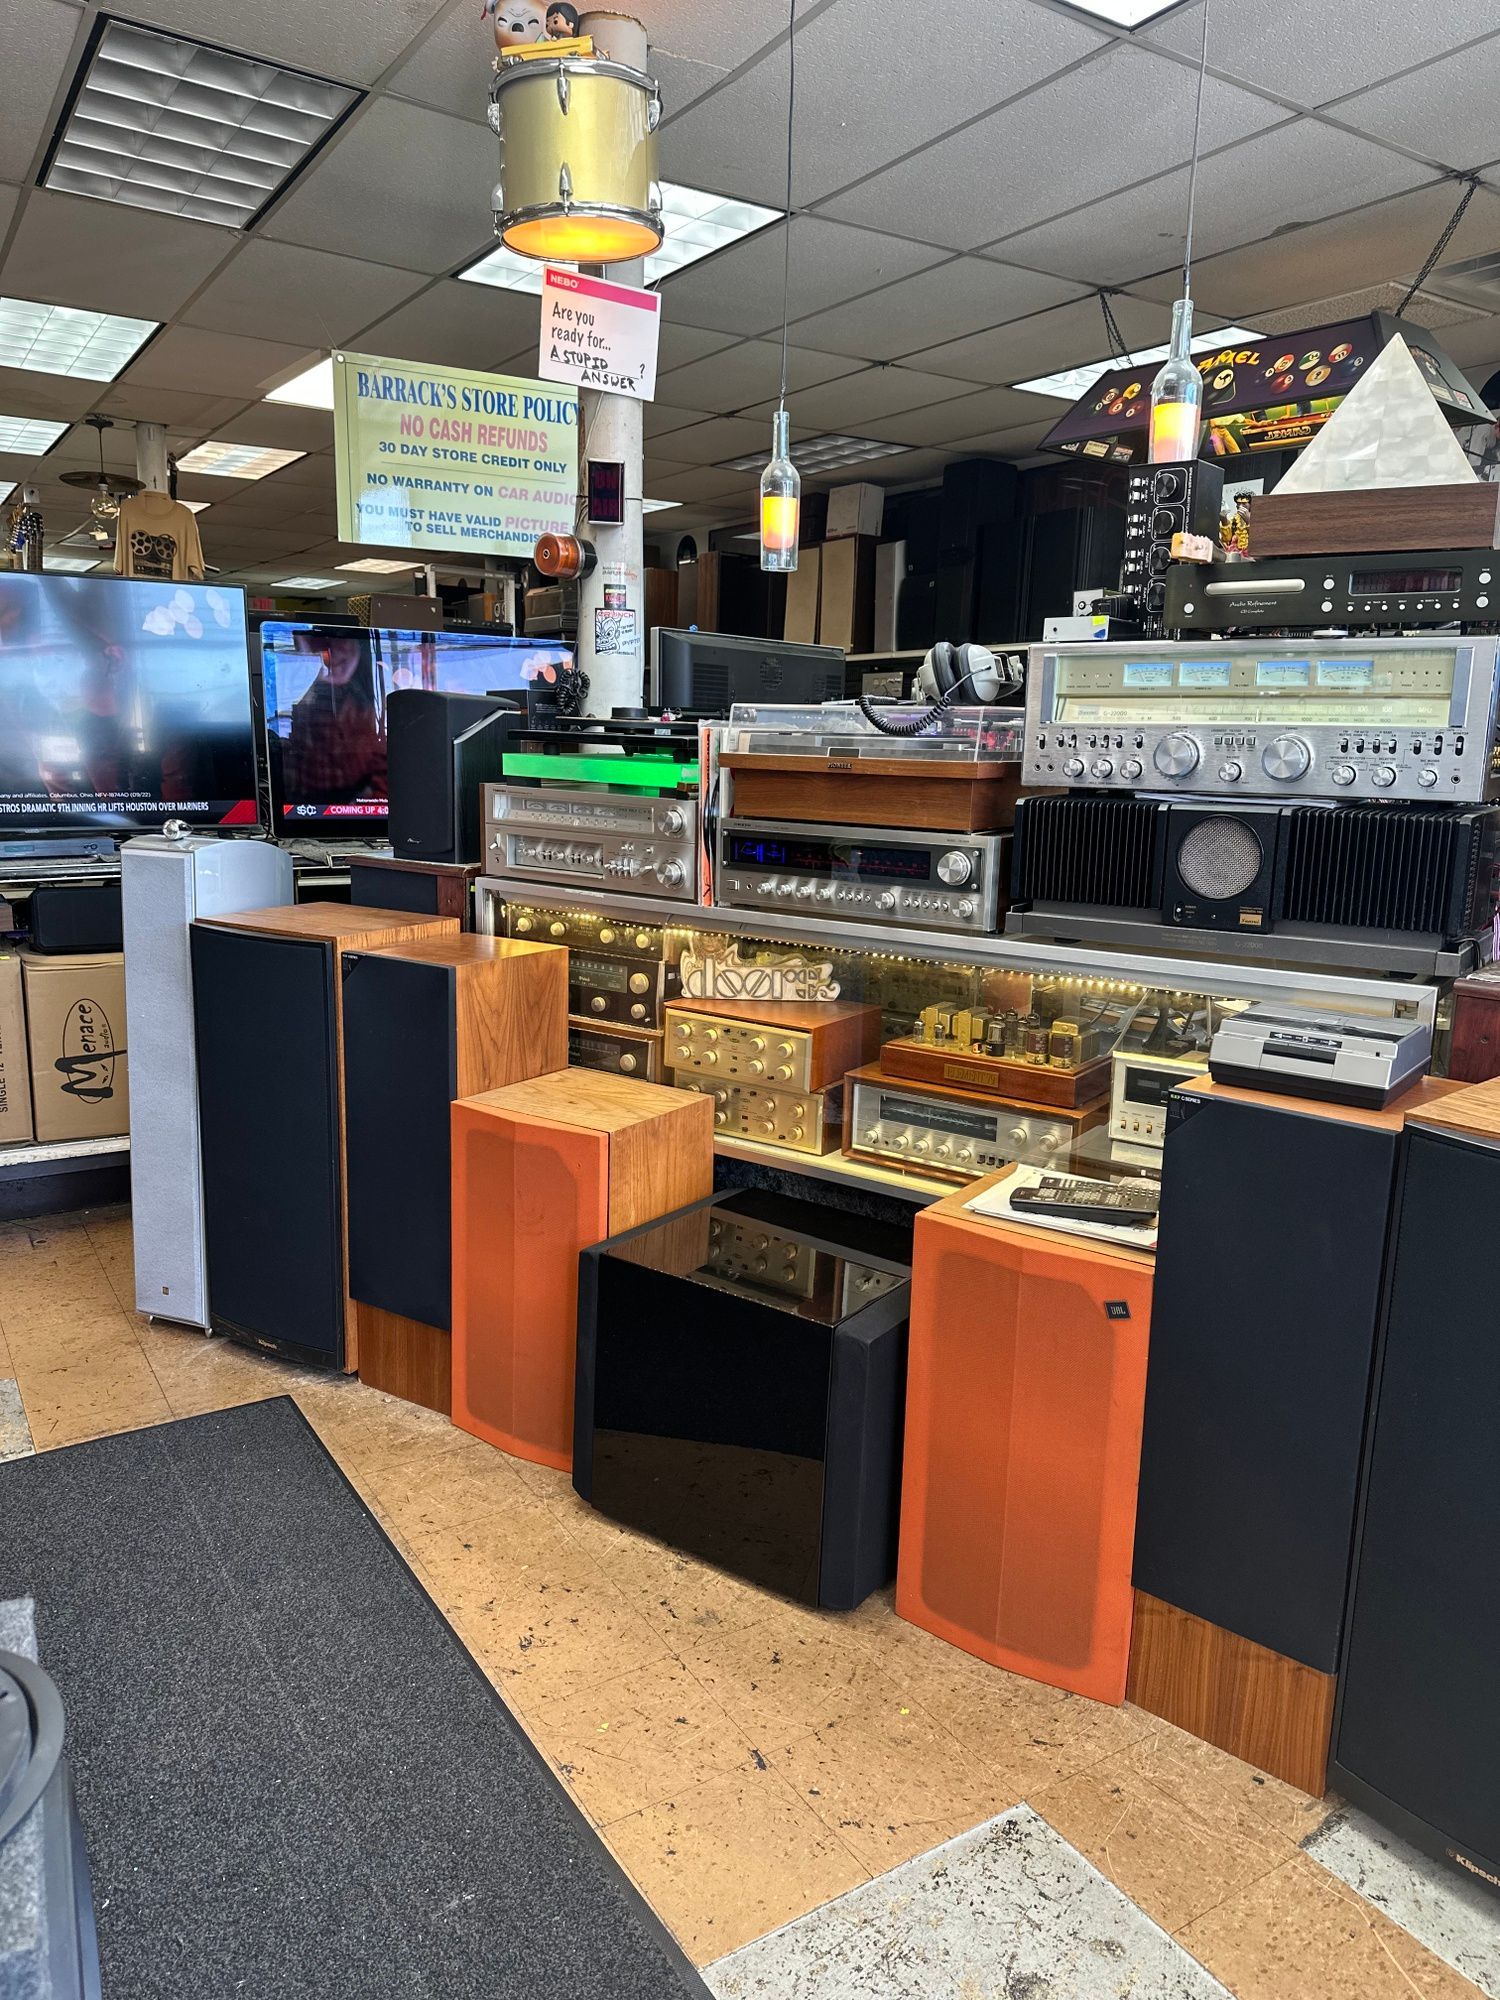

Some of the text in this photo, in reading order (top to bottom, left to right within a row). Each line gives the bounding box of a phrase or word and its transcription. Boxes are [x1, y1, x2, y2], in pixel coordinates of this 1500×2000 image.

[549, 273, 579, 289] NEBO
[552, 301, 595, 327] Are you
[551, 326, 611, 351] ready for...
[550, 344, 609, 370] A STUPID
[1196, 350, 1261, 375] AMEL
[581, 369, 637, 392] ANSWER
[640, 363, 646, 379] ?
[357, 371, 457, 410] BARRACK'S
[461, 388, 519, 418] STORE
[400, 414, 549, 454] NO CASH REFUNDS
[379, 441, 568, 474] 30 DAY STORE CREDIT ONLY
[366, 473, 388, 485] NO
[392, 475, 470, 494] WARRANTY
[474, 484, 493, 497] ON
[498, 486, 529, 501] CAR
[355, 502, 569, 534] YOU MUST HAVE VALID PICTURE
[406, 521, 540, 544] TO SELL MERCHANDIS
[21, 803, 57, 813] DRAMATIC
[57, 803, 70, 812] 9TH
[71, 802, 96, 812] INNING
[98, 802, 107, 812] HR
[108, 802, 124, 812] LIFTS
[126, 802, 158, 812] HOUSTON
[158, 802, 176, 811] OVER
[177, 802, 209, 811] MARINERS
[330, 806, 364, 814] COMING
[365, 806, 376, 814] UP
[688, 956, 819, 1000] doors
[55, 1003, 127, 1098] Menace
